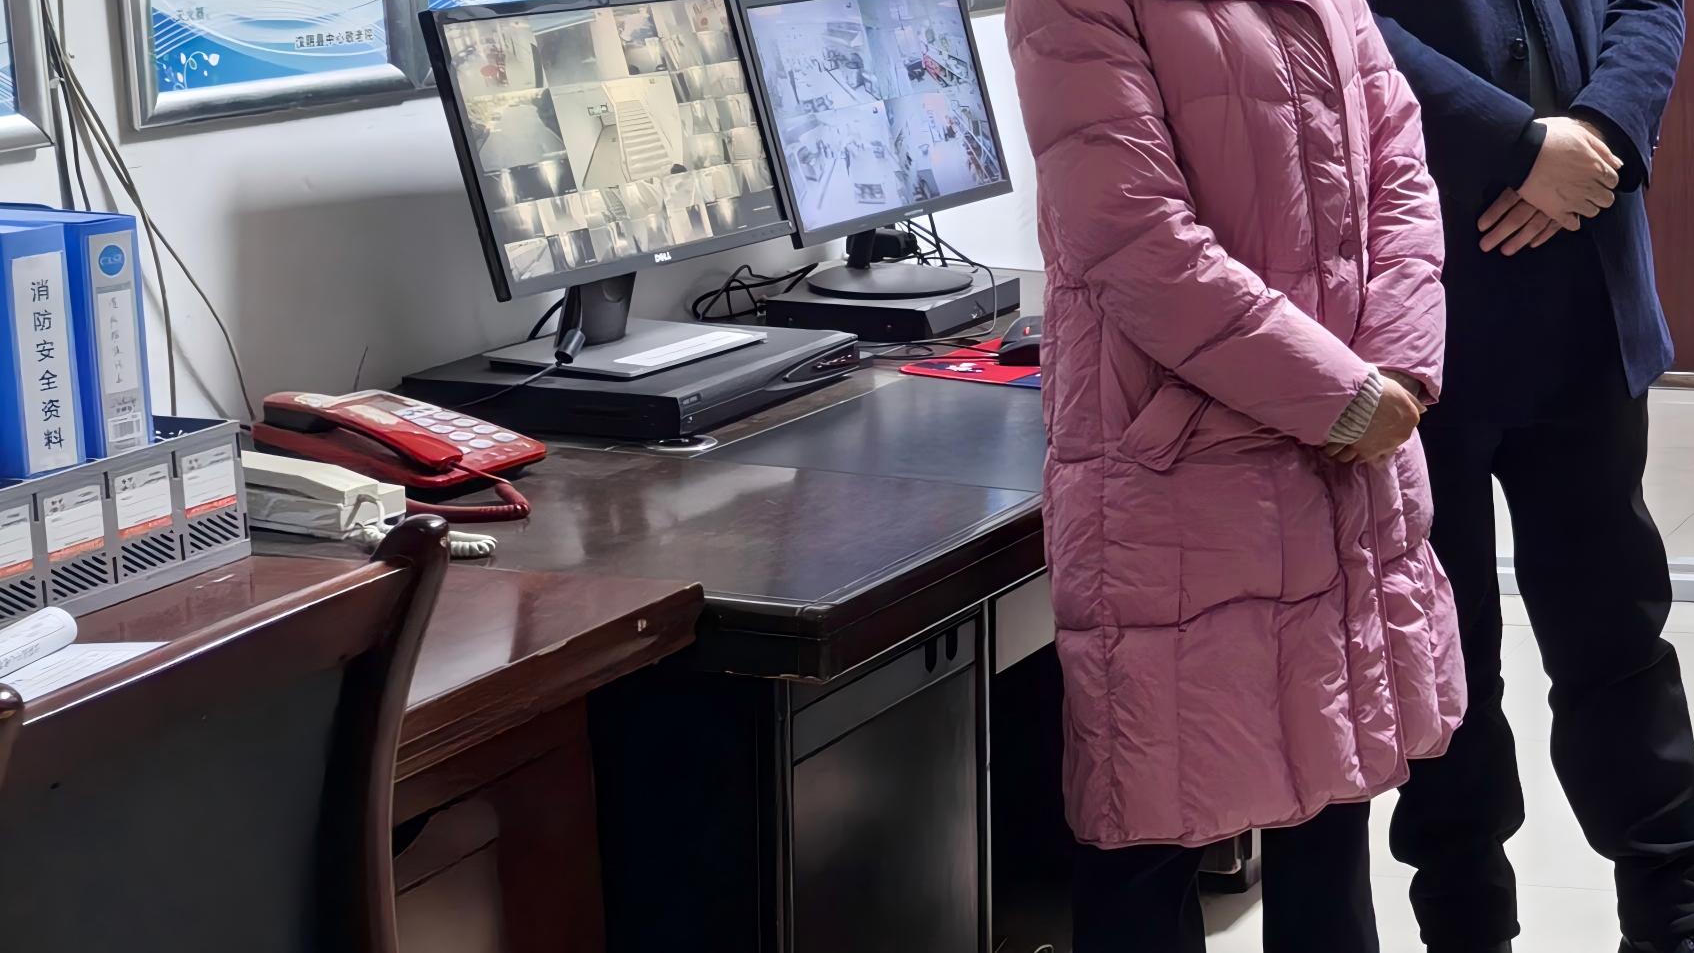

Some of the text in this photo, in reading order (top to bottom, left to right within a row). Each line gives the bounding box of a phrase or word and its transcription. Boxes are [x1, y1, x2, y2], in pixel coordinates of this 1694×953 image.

[30, 279, 65, 450] 消防安全资料
